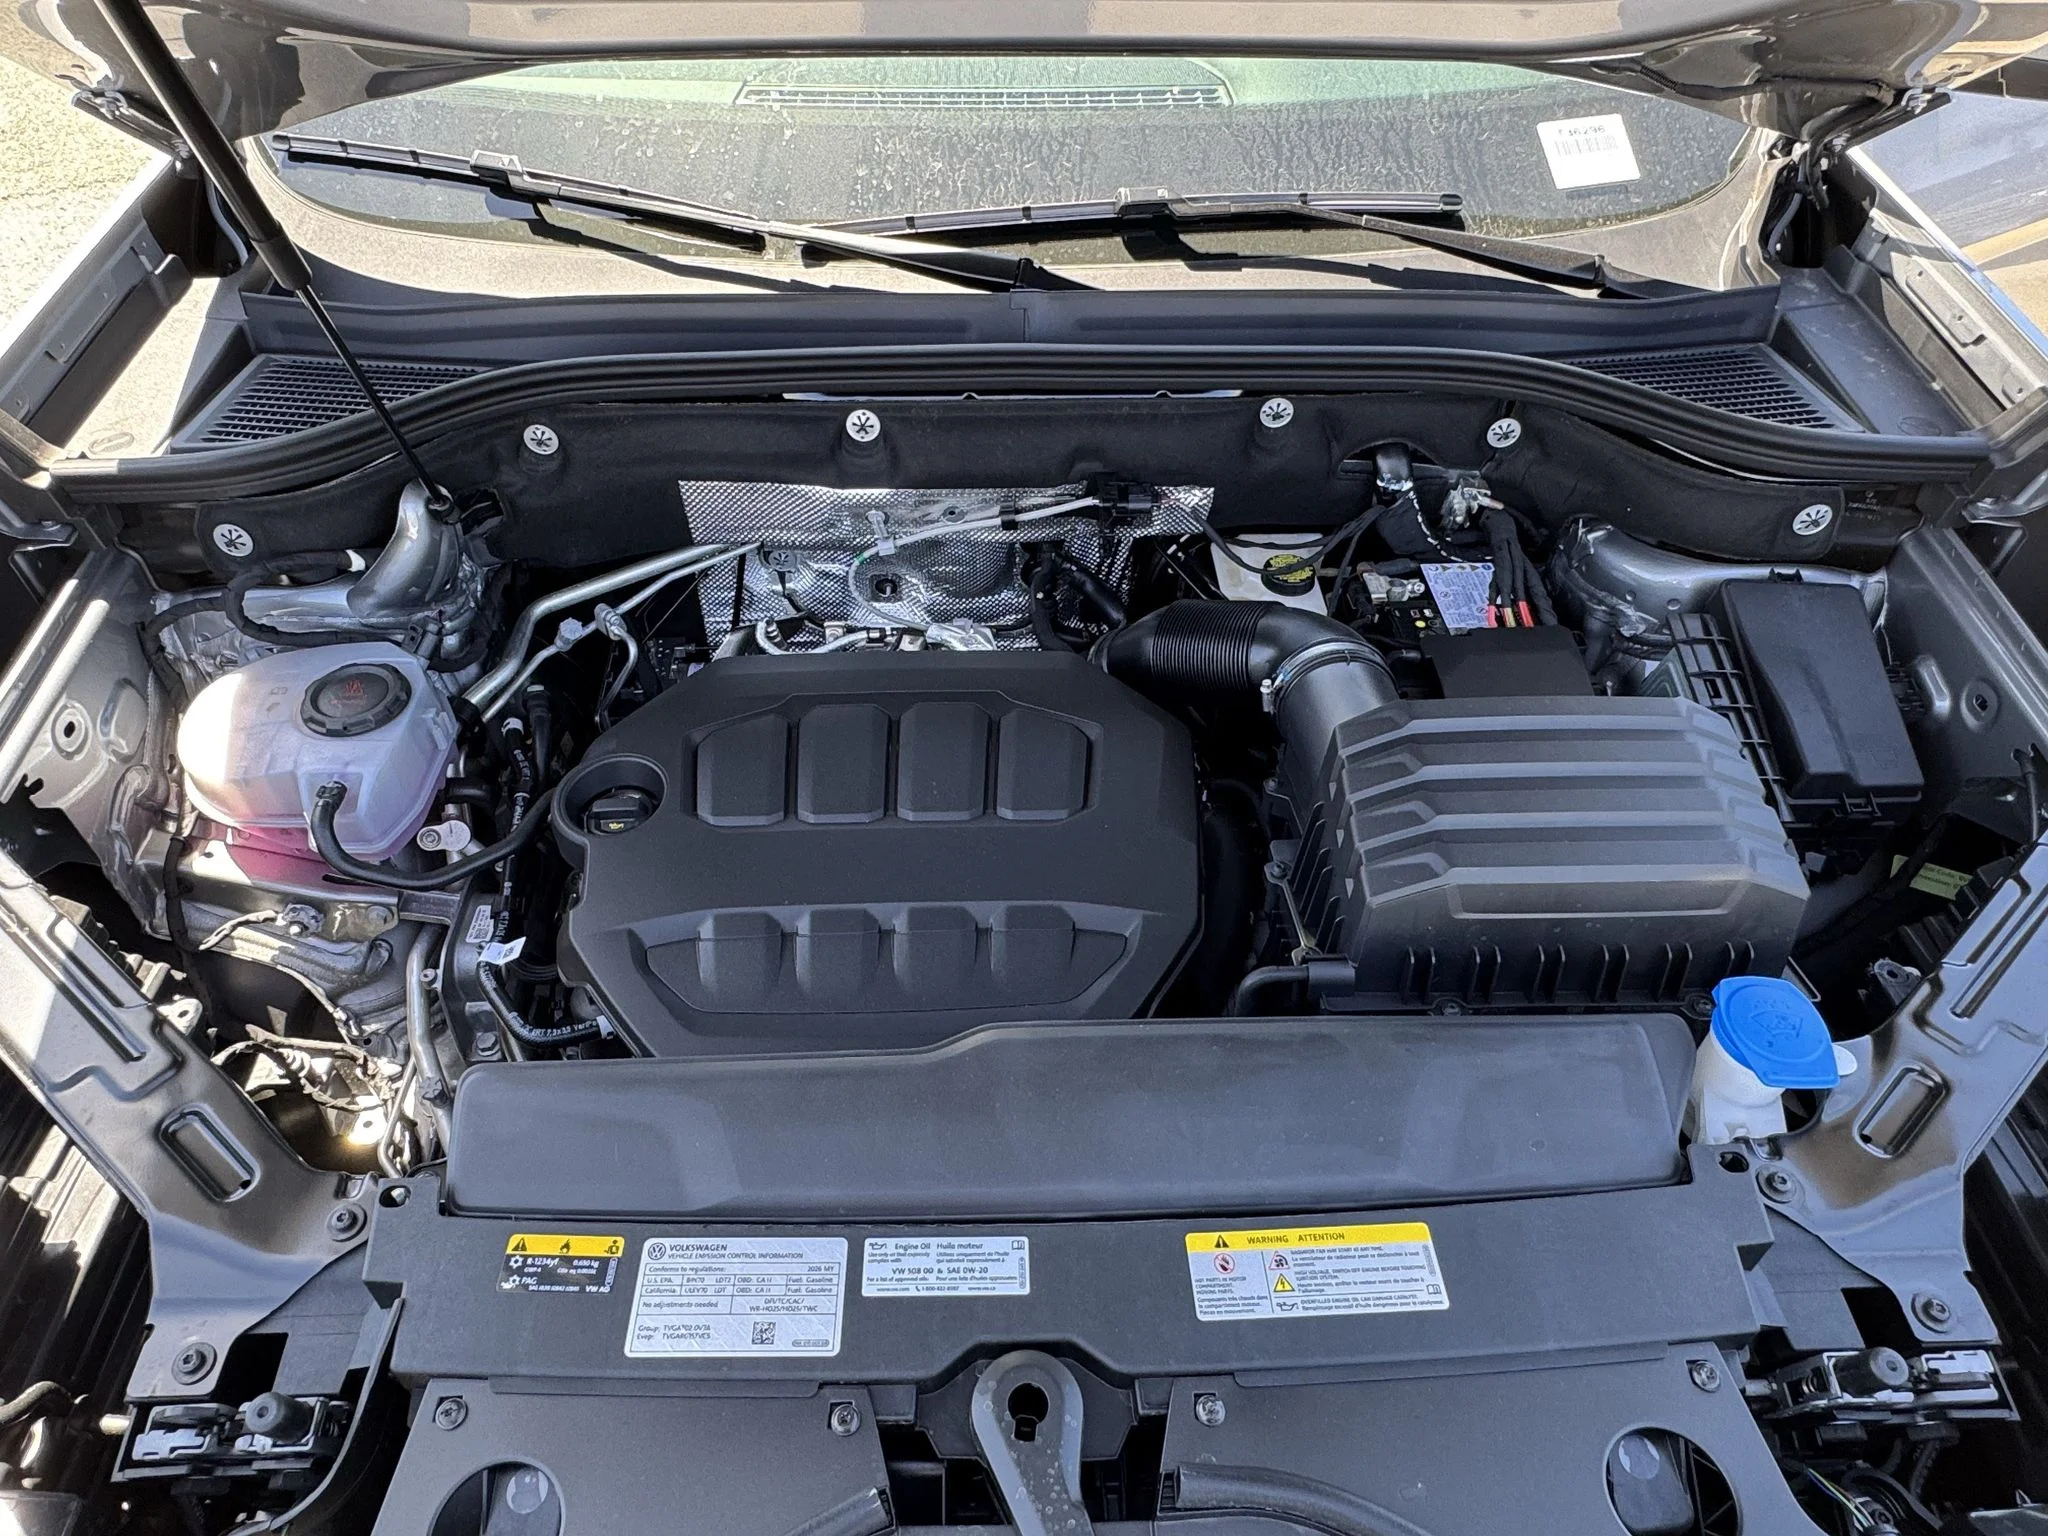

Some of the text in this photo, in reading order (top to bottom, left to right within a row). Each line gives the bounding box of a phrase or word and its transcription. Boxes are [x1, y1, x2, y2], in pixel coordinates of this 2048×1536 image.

[1247, 1232, 1345, 1244] WARNING ATTENTION
[895, 1243, 918, 1251] Engine
[526, 1258, 560, 1267] R-1234yf
